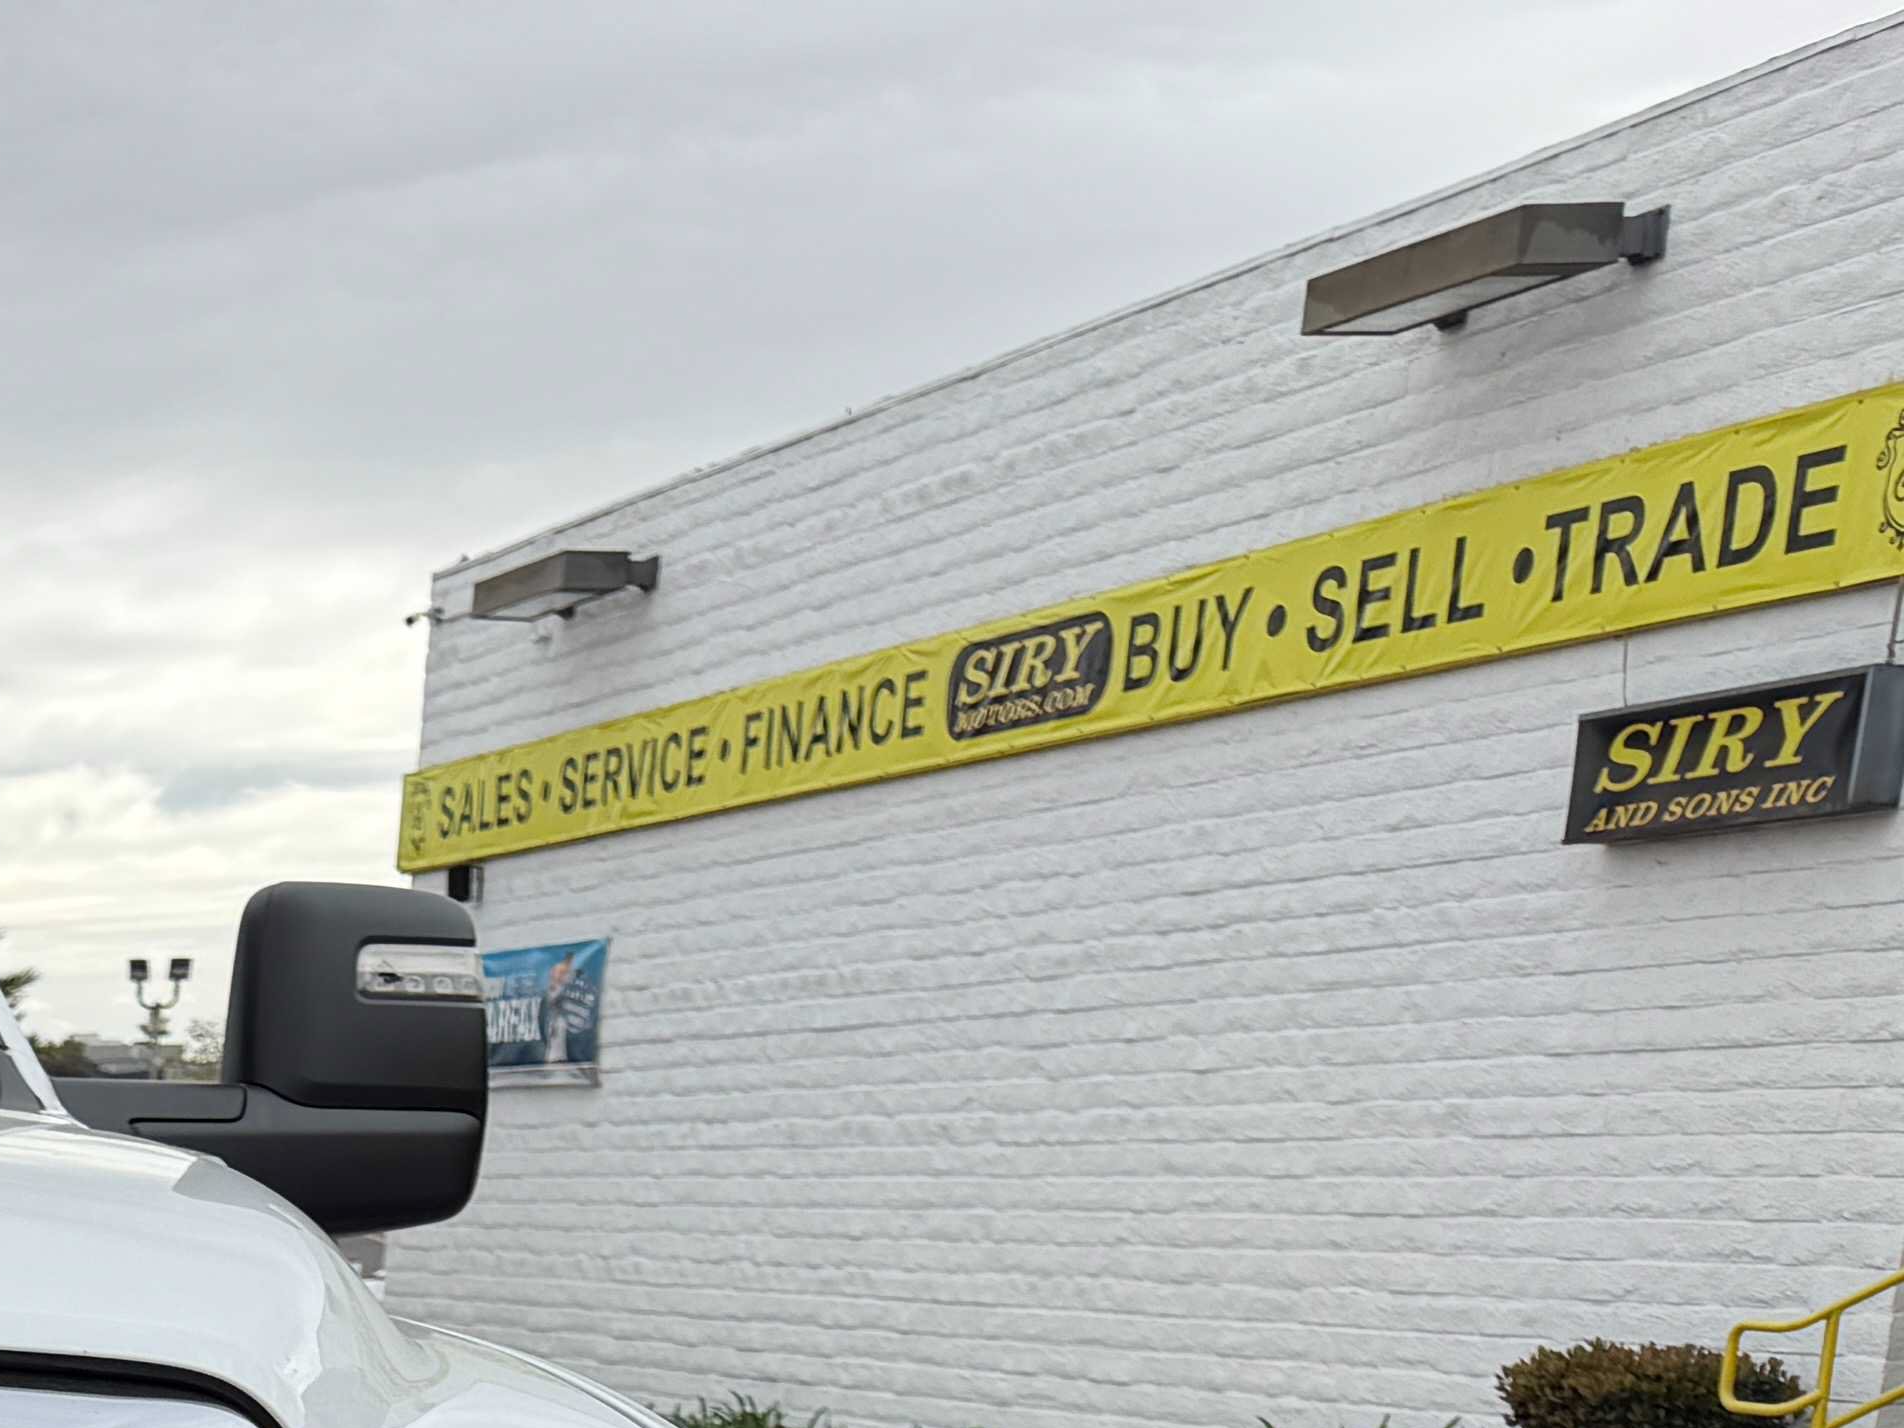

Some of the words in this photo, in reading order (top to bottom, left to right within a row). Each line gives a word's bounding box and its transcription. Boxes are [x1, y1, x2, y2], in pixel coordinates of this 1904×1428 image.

[1122, 586, 1255, 692] BUY
[1306, 537, 1484, 653] SELL
[1544, 445, 1848, 602] TRADE
[955, 620, 1104, 706] SIRY
[954, 682, 1095, 733] MOTORS.COM
[1594, 690, 1844, 794] SIRY
[438, 768, 534, 838] SALES
[559, 726, 709, 814] SERVICE
[739, 670, 929, 774] FINANCE
[1584, 800, 1658, 832] AND
[1662, 786, 1761, 823] SONS
[1761, 775, 1836, 810] INC
[484, 996, 542, 1044] ARFAX
